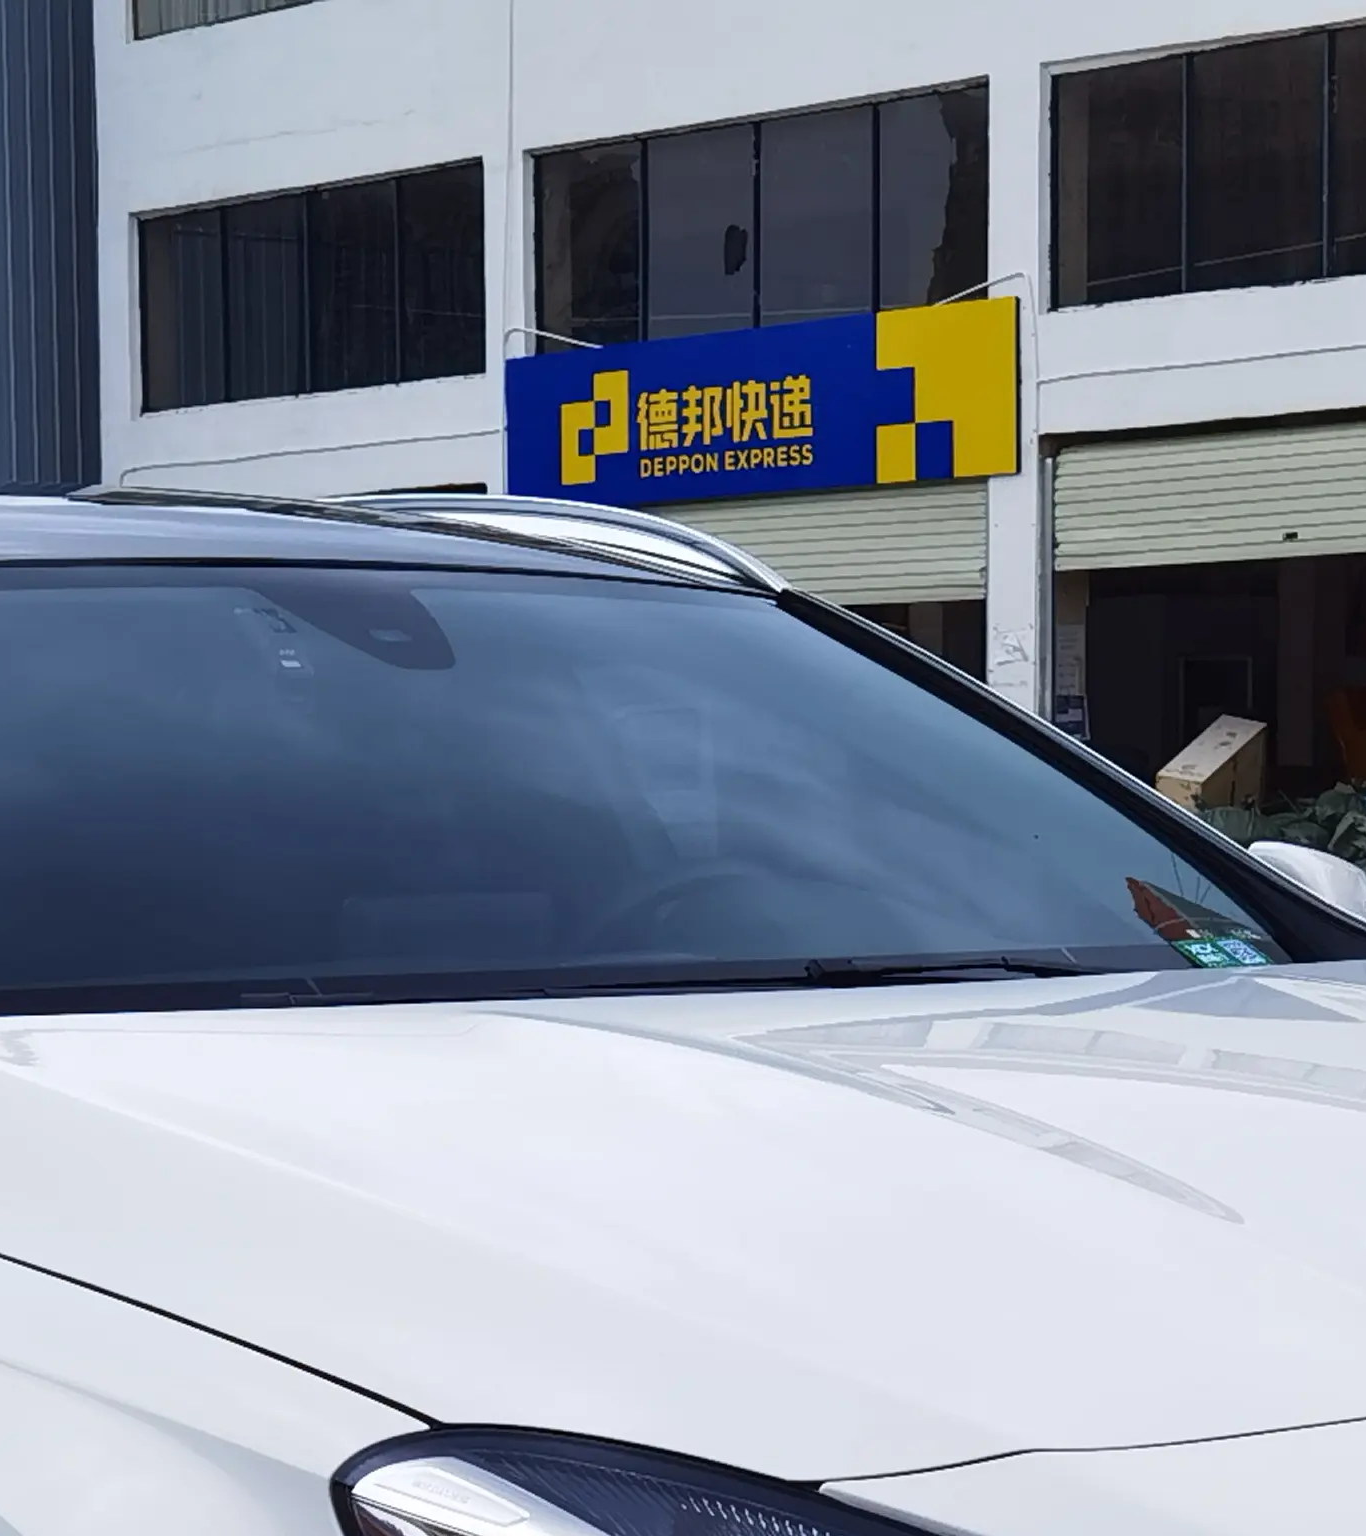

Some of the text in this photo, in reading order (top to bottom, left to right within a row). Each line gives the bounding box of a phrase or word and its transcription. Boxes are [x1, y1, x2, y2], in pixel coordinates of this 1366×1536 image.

[636, 374, 813, 451] 德邦快递
[639, 444, 813, 479] DEPPON EXPRESS
